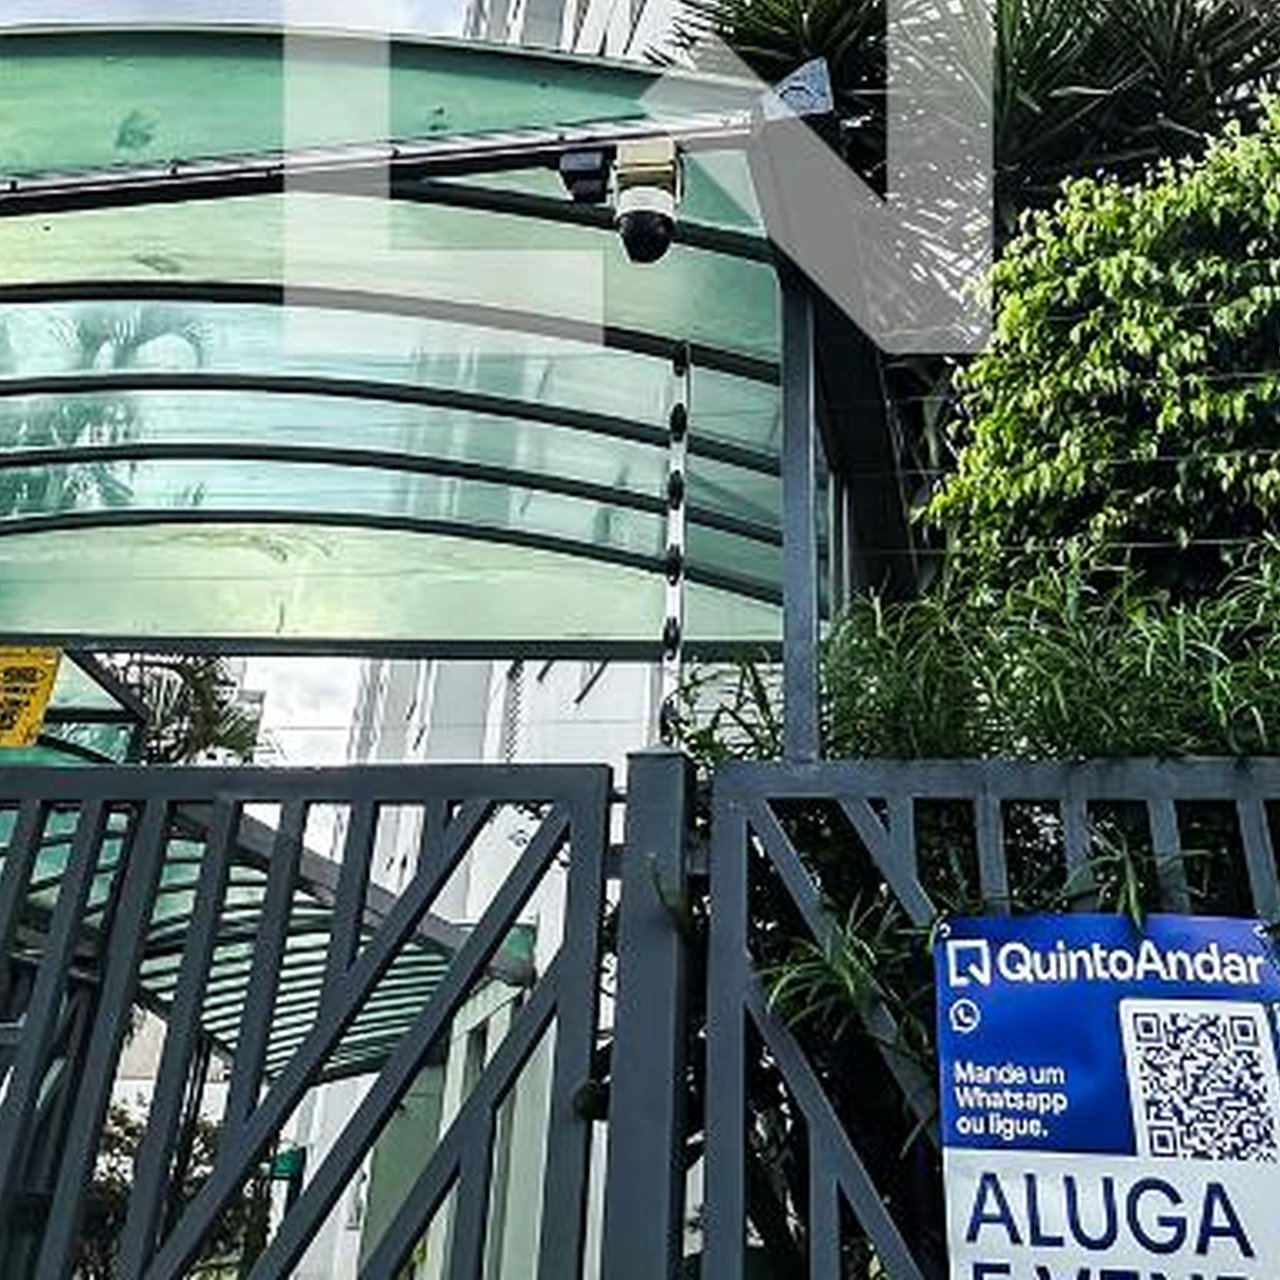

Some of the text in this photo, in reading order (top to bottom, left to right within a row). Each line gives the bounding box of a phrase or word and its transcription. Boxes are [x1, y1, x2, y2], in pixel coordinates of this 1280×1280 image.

[997, 939, 1264, 984] QuintoAndar
[954, 1060, 1065, 1084] Mande um
[954, 1086, 1068, 1115] Whatsapp
[956, 1112, 1049, 1141] ou ligue.
[965, 1171, 1255, 1259] ALUGA
